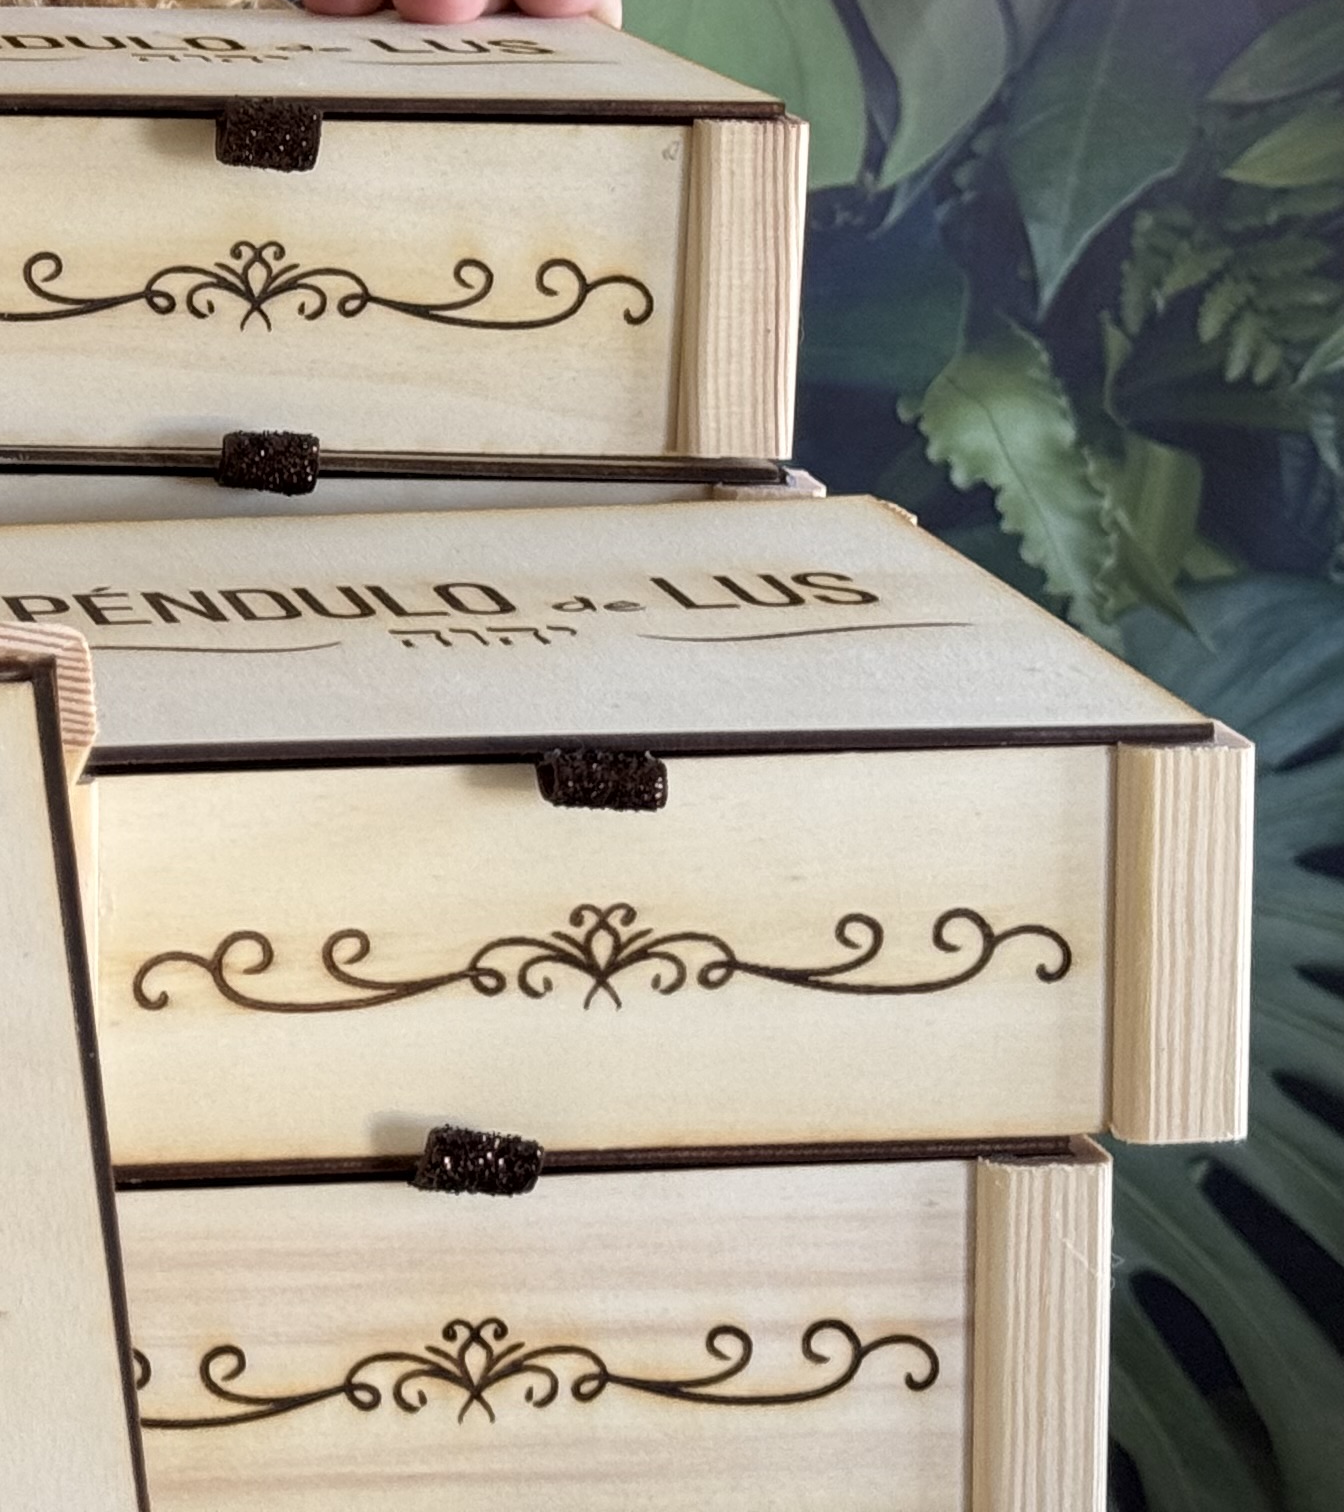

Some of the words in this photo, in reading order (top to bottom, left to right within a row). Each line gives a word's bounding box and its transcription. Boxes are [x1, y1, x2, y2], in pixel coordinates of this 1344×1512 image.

[369, 39, 554, 55] LUS
[2, 582, 515, 624] PÉNDULO
[550, 594, 646, 613] de
[649, 572, 881, 609] LUS
